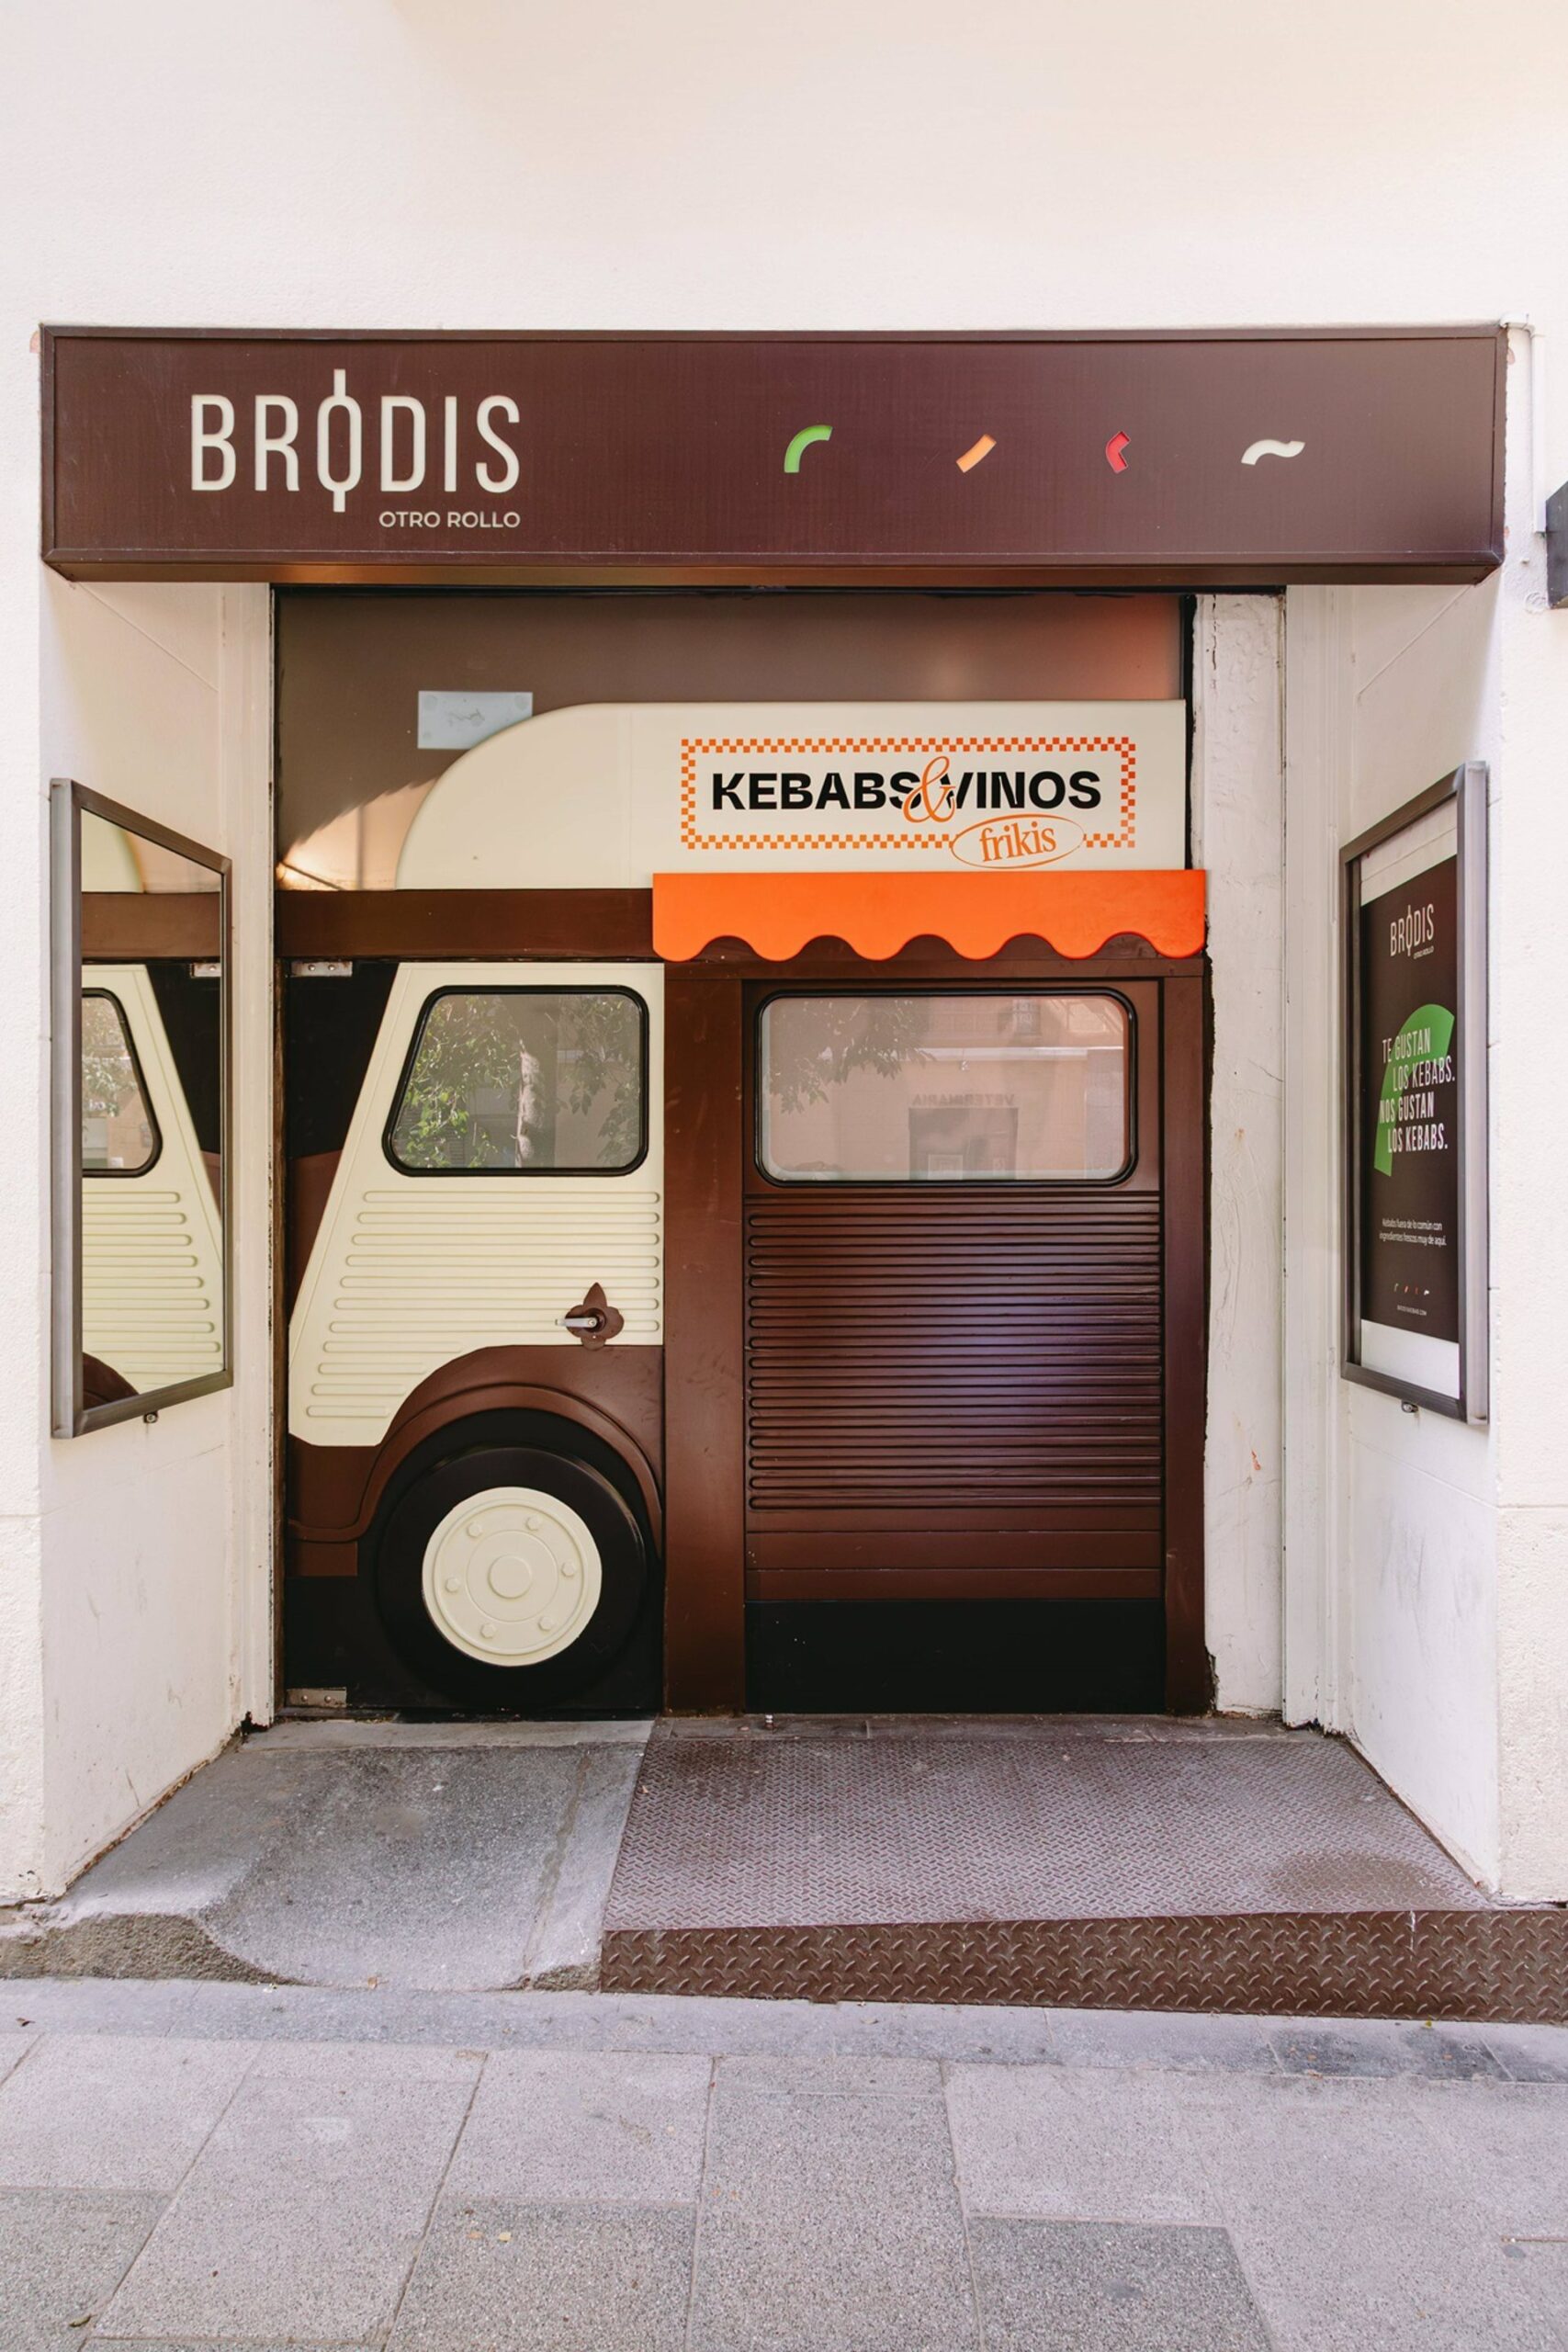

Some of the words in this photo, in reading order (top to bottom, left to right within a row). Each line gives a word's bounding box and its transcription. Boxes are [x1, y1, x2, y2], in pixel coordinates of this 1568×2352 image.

[378, 511, 441, 528] OTRO
[446, 511, 521, 528] ROLLO
[712, 771, 922, 810] KEBABS
[940, 771, 1102, 810] VINOS
[978, 820, 1057, 864] frikis
[1382, 1038, 1393, 1064] TE
[1394, 1027, 1431, 1061] GUSTAN
[1393, 1064, 1409, 1092] LOS
[1412, 1055, 1456, 1089] KEBABS.
[1379, 1098, 1395, 1124] NOS
[1398, 1091, 1435, 1123] GUSTAN
[1387, 1126, 1403, 1154] LOS
[1404, 1123, 1449, 1152] KEBABS.
